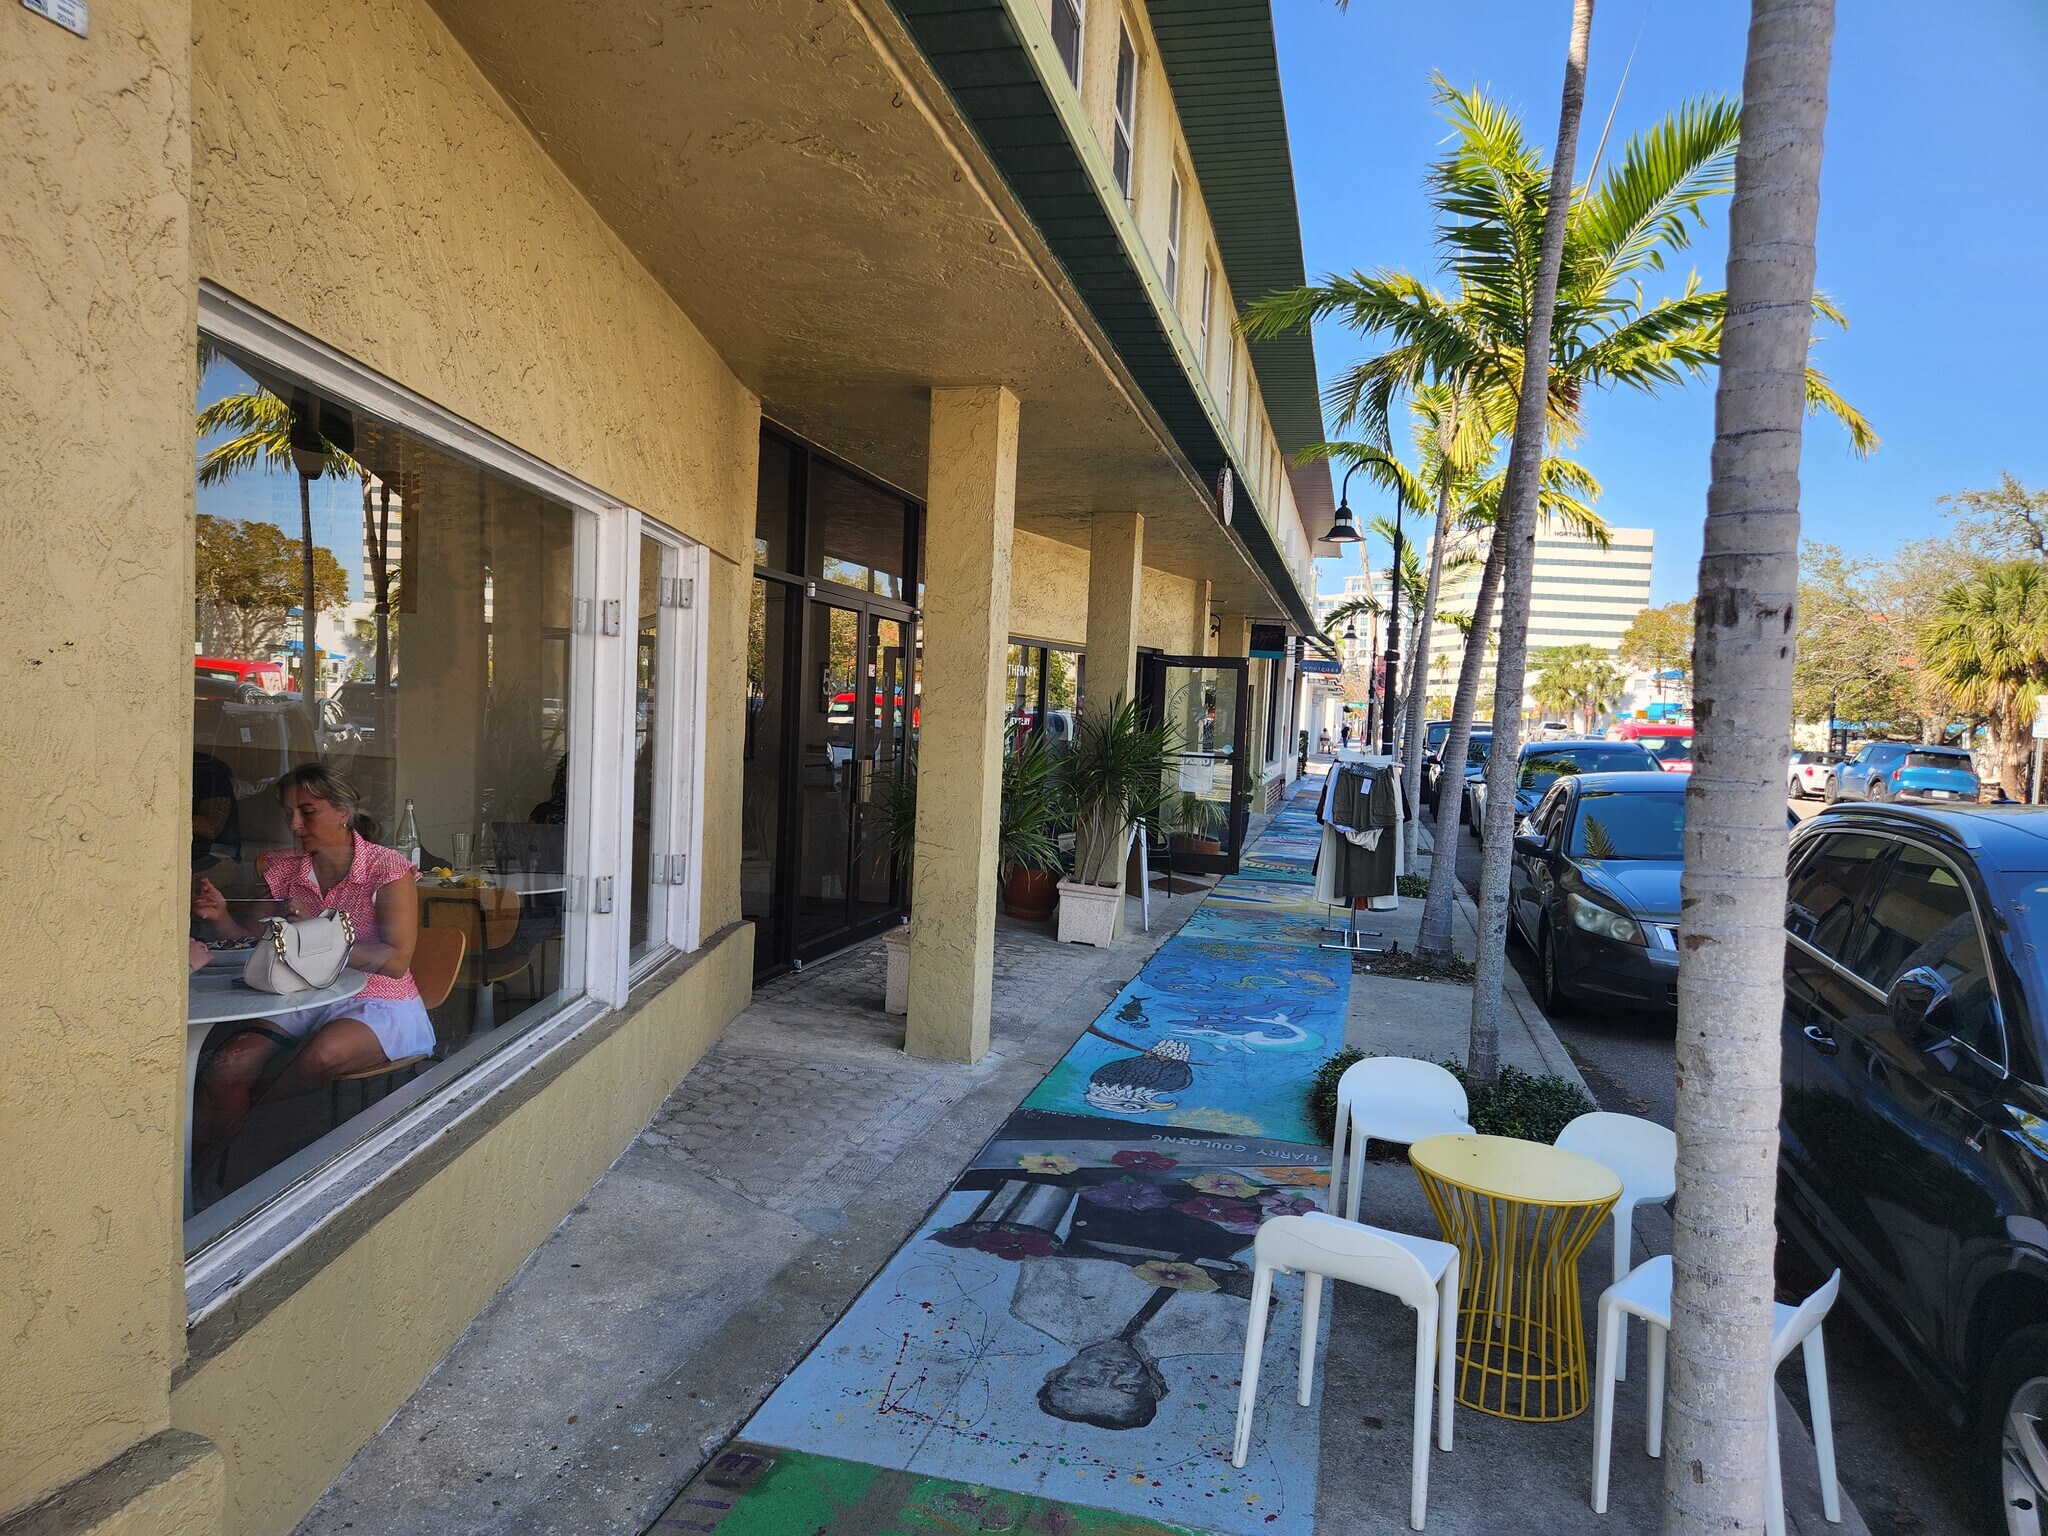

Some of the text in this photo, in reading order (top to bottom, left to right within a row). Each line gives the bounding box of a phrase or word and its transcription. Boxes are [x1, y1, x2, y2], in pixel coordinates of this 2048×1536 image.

[1554, 531, 1591, 539] NORTHER
[1007, 664, 1036, 678] THERAPY
[1151, 1134, 1318, 1163] HARRY GOULDING
